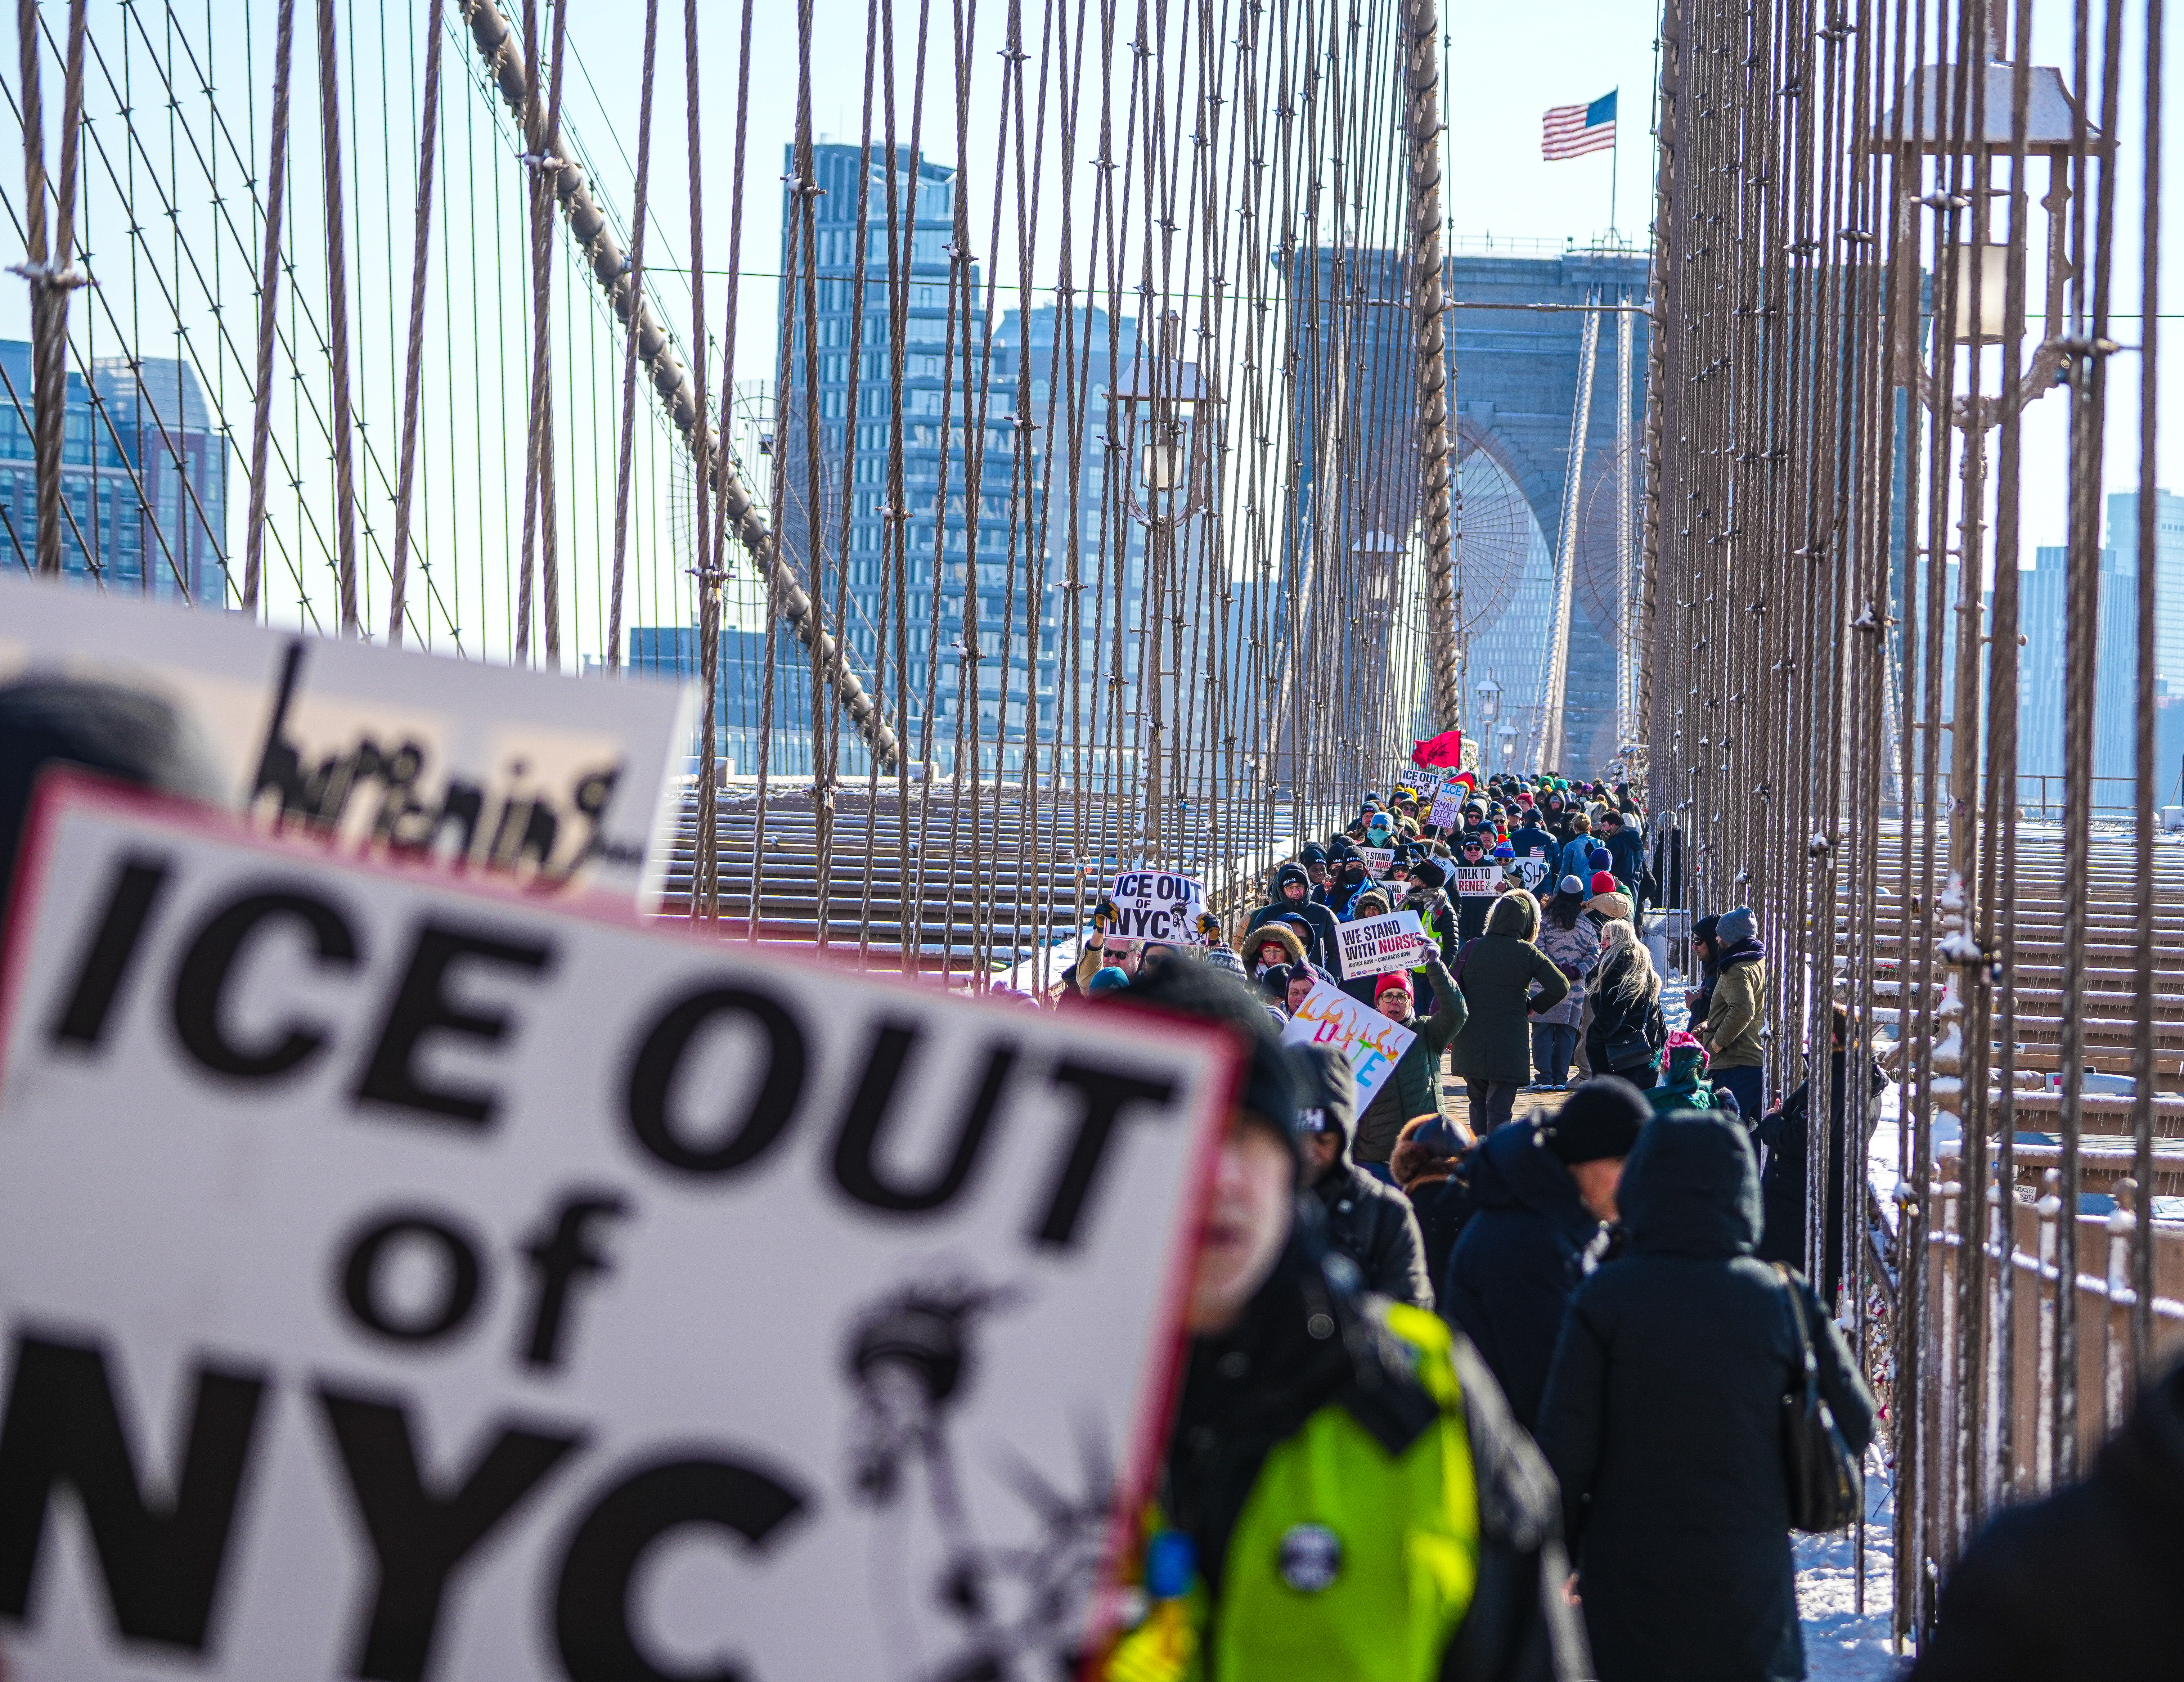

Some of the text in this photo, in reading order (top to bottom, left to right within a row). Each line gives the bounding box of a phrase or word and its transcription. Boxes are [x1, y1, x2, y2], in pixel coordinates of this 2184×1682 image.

[1402, 770, 1439, 784] ICE OUT
[1442, 784, 1462, 796] ICE
[1434, 799, 1458, 813] SMALL
[1433, 809, 1451, 819] DICK
[1428, 815, 1455, 828] ENERGY
[1370, 852, 1390, 861] STAND
[1458, 868, 1479, 880] MLK
[1480, 868, 1491, 879] TO
[1115, 874, 1202, 904] ICE OUT
[1459, 880, 1485, 891] RENEE
[1136, 899, 1151, 908] OF
[1109, 907, 1170, 939] NYC
[1342, 919, 1401, 946] WE STAND
[1345, 941, 1377, 961] WITH
[1378, 953, 1400, 962] CONTRACTS
[45, 846, 1188, 1255] ICE OUT
[337, 1188, 630, 1375] of
[0, 1323, 814, 1682] NYC
